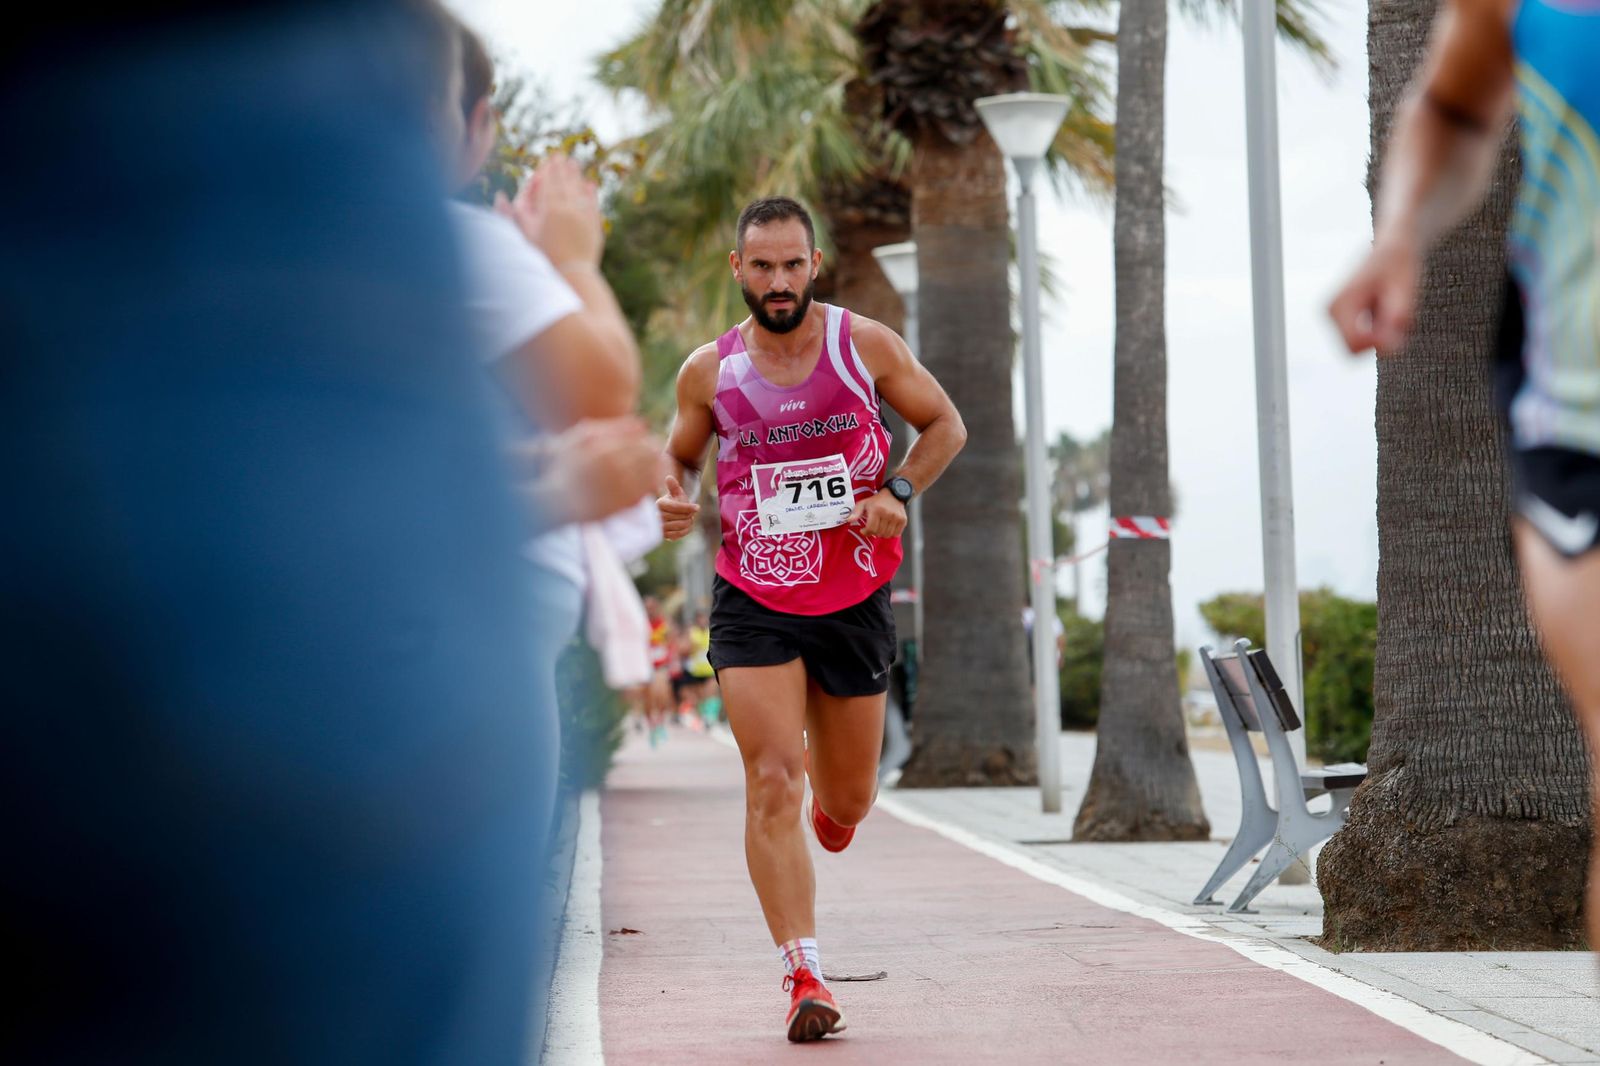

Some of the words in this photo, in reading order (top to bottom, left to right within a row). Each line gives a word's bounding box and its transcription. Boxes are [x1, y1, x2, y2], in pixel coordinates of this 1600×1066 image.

[739, 431, 760, 447] LA
[767, 412, 859, 444] ANTORCHA
[785, 477, 847, 504] 716
